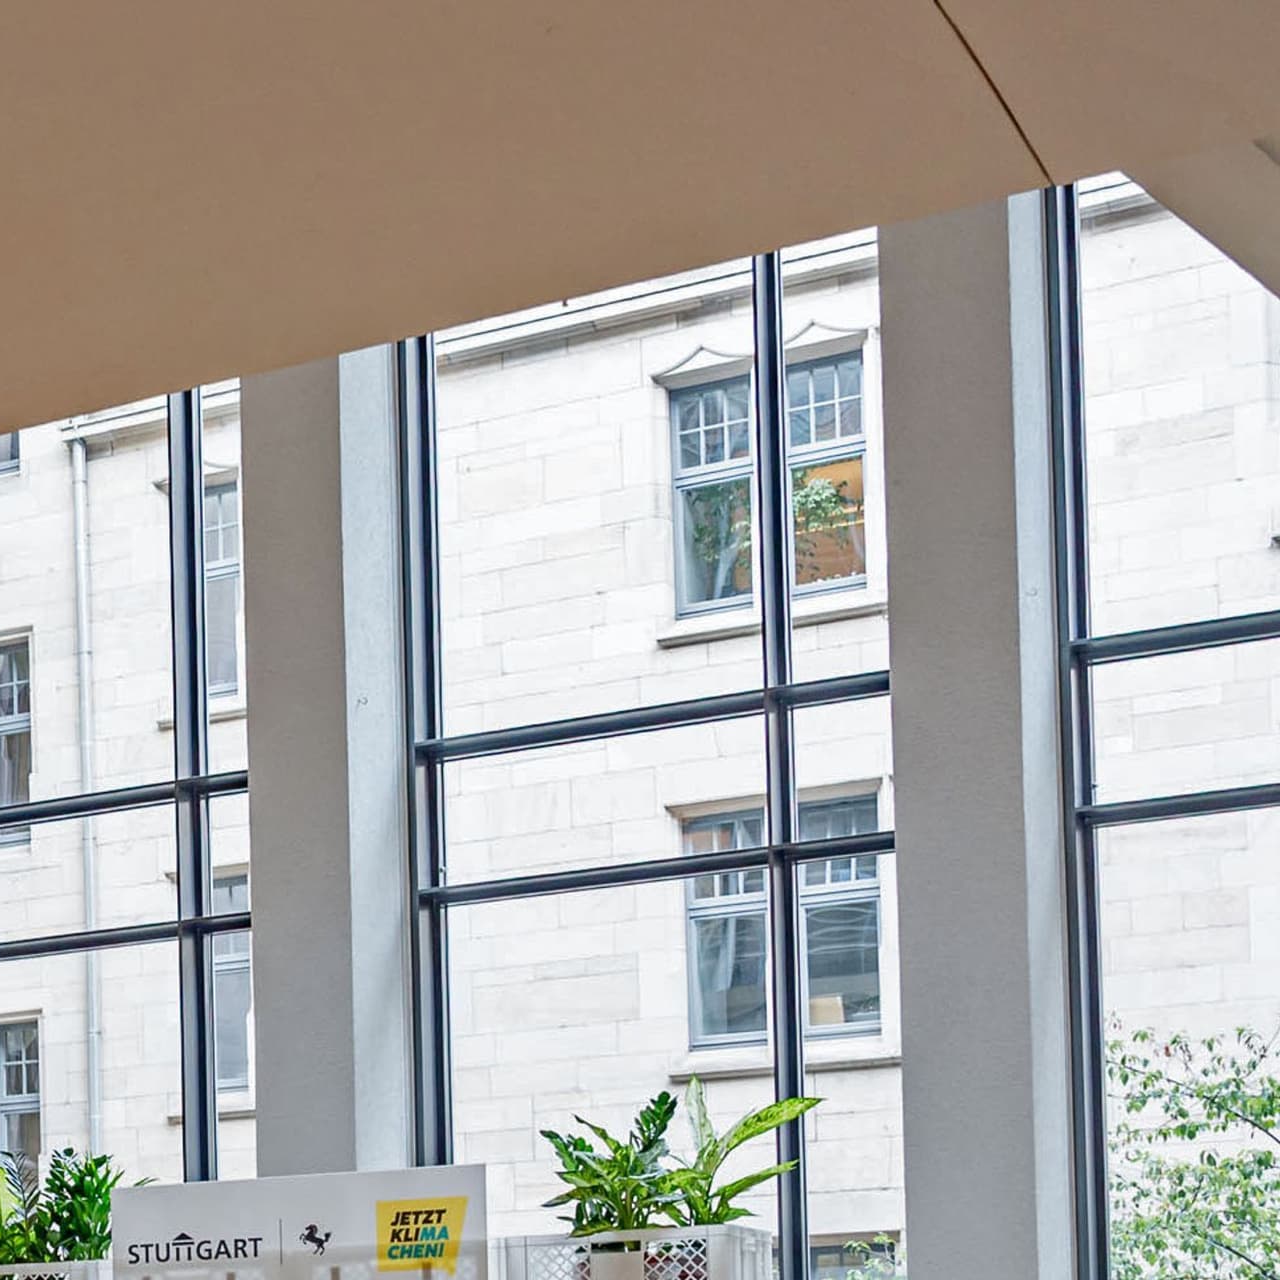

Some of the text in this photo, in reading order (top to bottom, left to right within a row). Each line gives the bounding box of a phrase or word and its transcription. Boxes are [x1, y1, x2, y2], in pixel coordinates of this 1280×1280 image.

[390, 1209, 447, 1227] JETZT
[389, 1225, 450, 1243] KLIMA
[127, 1232, 263, 1265] STUTTGART
[387, 1243, 445, 1261] CHEN!
